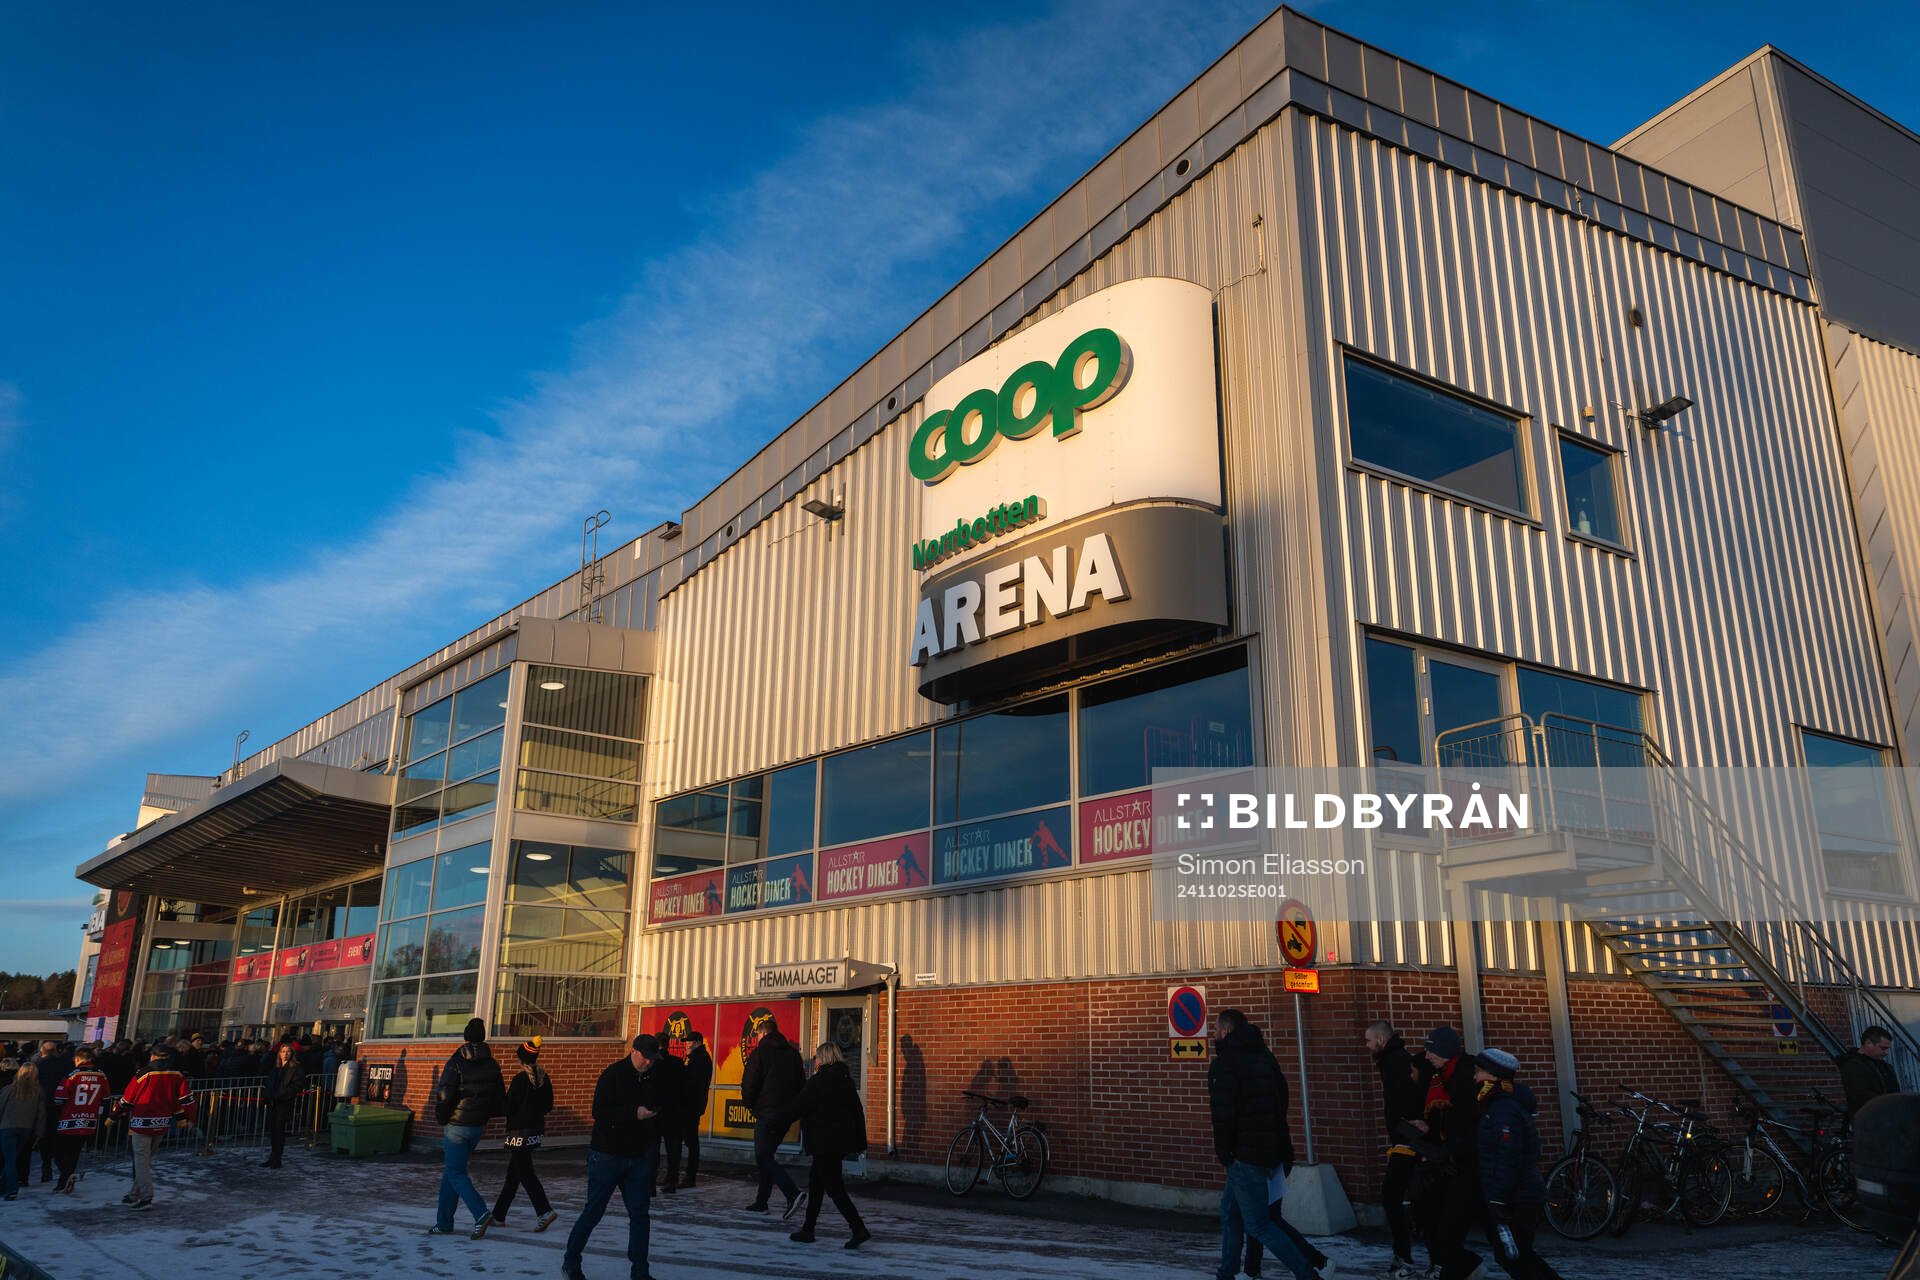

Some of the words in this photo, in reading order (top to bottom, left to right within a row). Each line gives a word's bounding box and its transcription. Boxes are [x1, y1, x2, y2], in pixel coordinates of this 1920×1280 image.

[909, 328, 1130, 482] coop
[913, 493, 1045, 570] Norrbotten
[910, 533, 1128, 667] ARENA
[1095, 799, 1152, 823] ALLSTAR
[945, 826, 990, 848] ALLSTAR
[1093, 820, 1151, 856] HOCKEY
[828, 850, 865, 868] ALLSTAR
[944, 845, 990, 878] HOCKEY
[994, 837, 1033, 871] DINER
[732, 868, 764, 883] ALLSTAR
[827, 863, 864, 895] HOCKEY
[867, 859, 899, 888] DINER
[654, 894, 682, 919] HOCKEY
[683, 891, 705, 915] DINER
[731, 881, 762, 909] HOCKEY
[764, 877, 791, 904] DINER
[758, 964, 839, 989] HEMMALAGET
[369, 1067, 392, 1080] BILJETTER
[74, 1084, 101, 1106] 67
